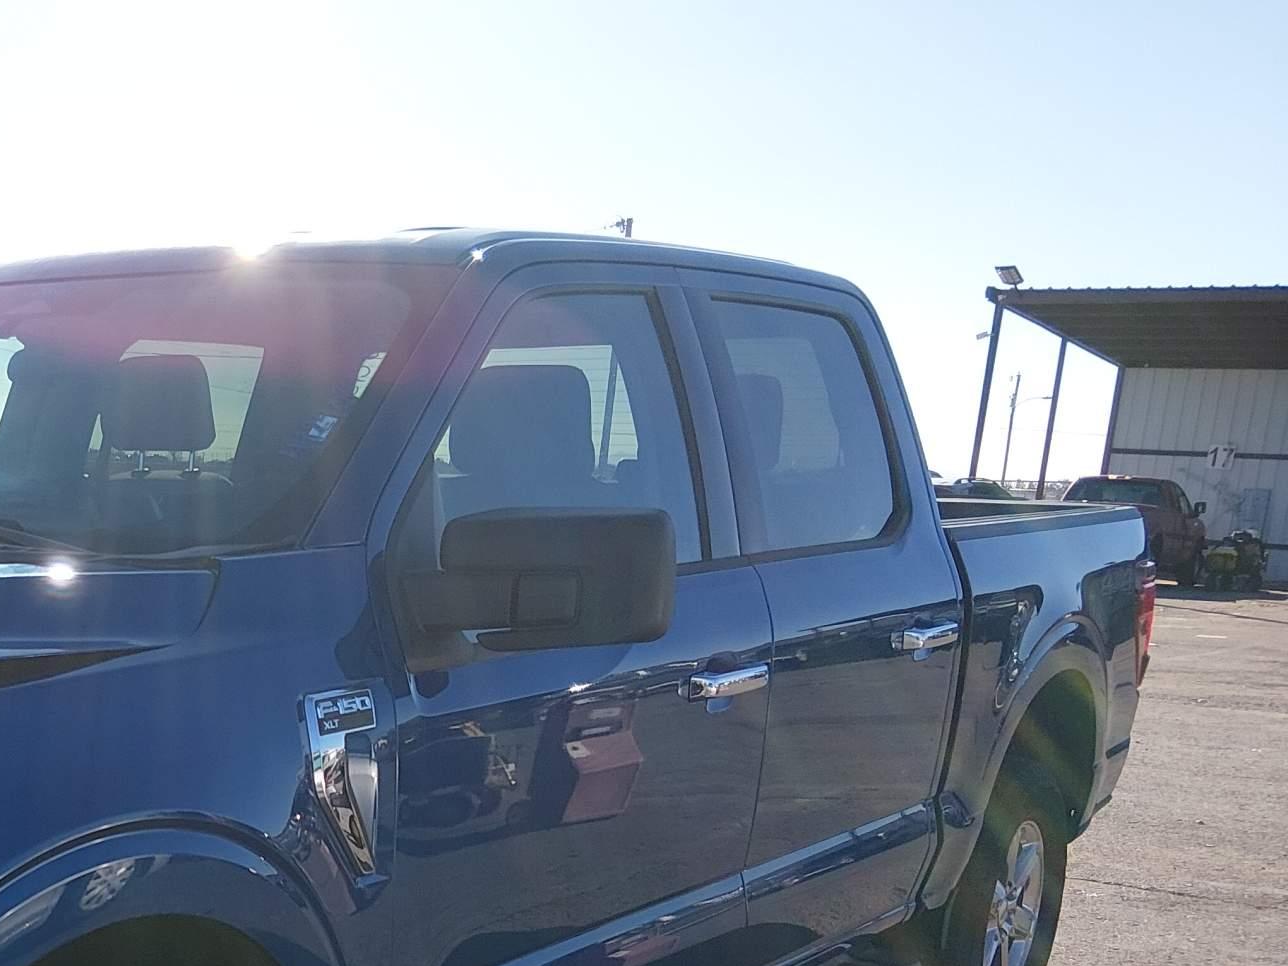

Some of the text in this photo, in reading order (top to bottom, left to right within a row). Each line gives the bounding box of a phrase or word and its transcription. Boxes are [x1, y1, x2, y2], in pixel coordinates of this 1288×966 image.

[1209, 447, 1234, 467] 17
[317, 696, 371, 719] F-150
[323, 719, 340, 730] XLT
